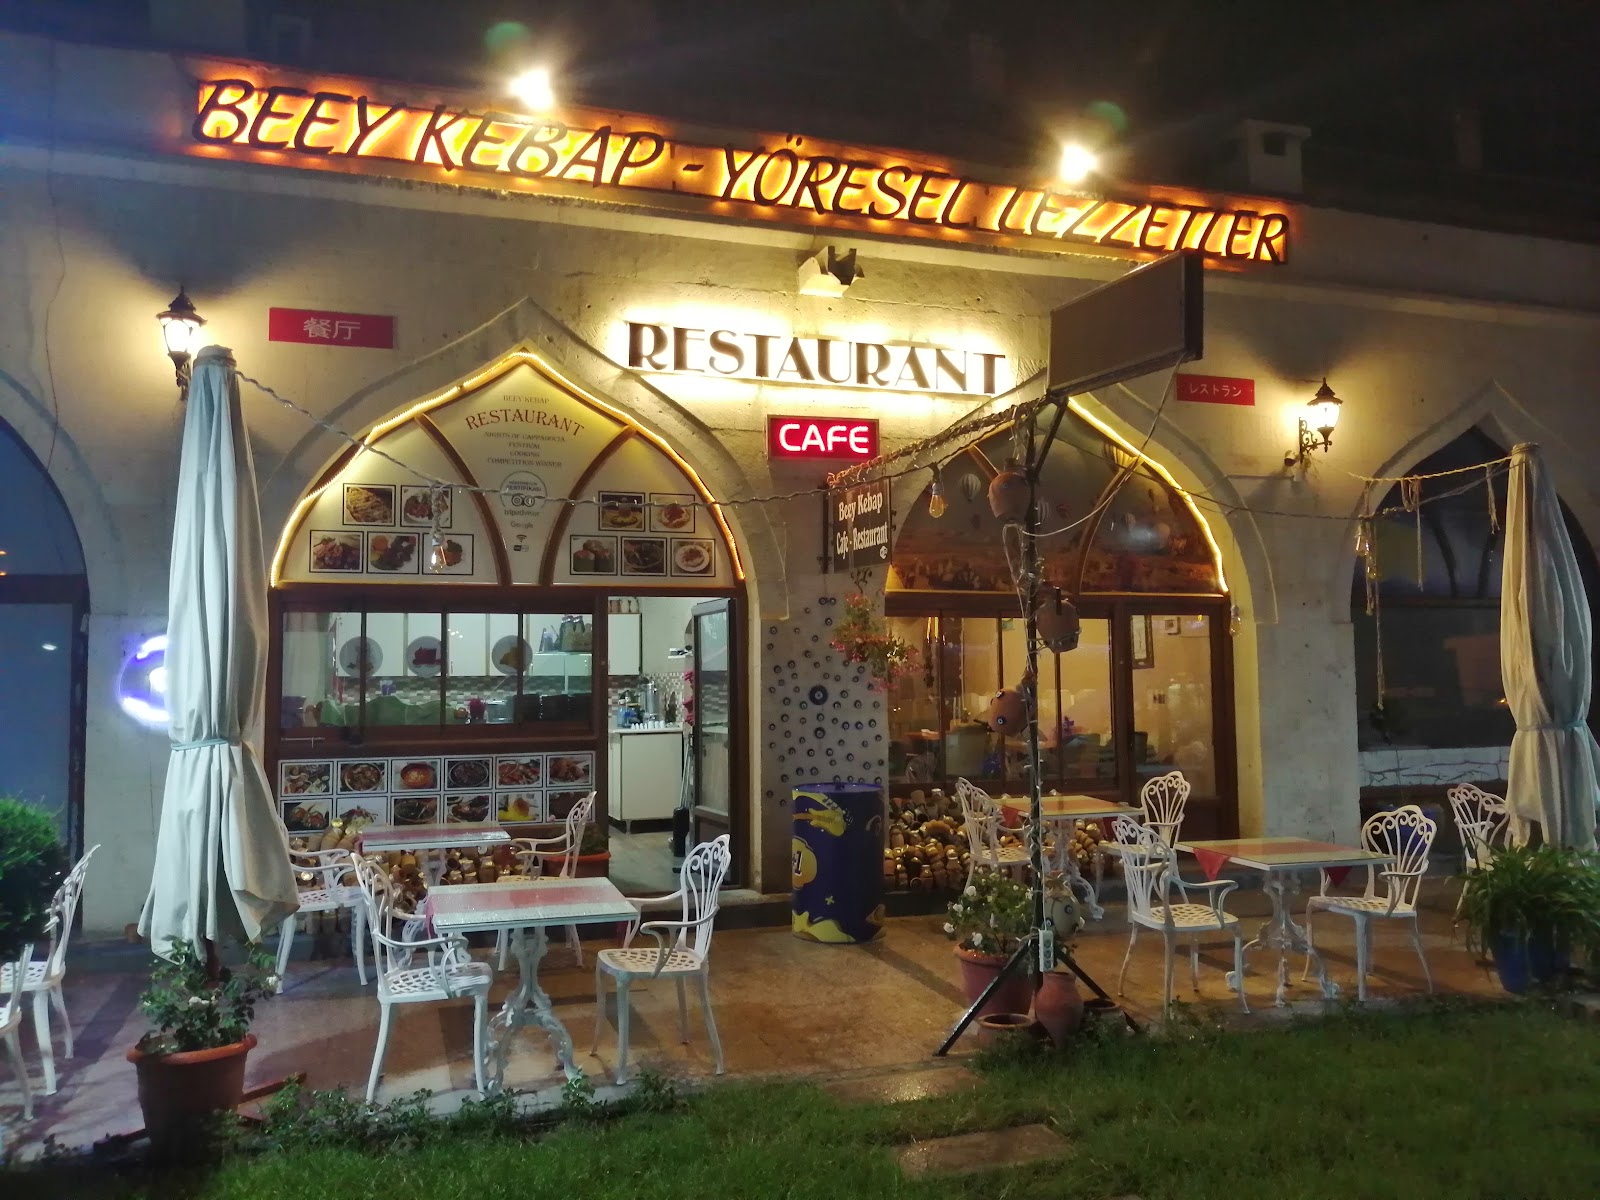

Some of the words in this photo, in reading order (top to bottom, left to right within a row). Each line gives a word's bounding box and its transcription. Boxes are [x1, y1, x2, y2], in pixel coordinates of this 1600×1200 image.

[192, 78, 406, 155] BEEY
[415, 104, 665, 187] KEBAP
[718, 134, 975, 231] YÖRESEL
[998, 186, 1291, 265] LEZZETLER
[303, 317, 361, 340] 餐厅
[626, 321, 1007, 394] RESTAURANT
[1190, 384, 1242, 397] レストラン
[465, 409, 585, 436] RESTAURANT
[508, 442, 541, 450] FESTIVAL
[779, 423, 869, 454] CAFE
[487, 457, 534, 466] COMPETITION
[535, 460, 562, 468] WINNER
[509, 450, 540, 458] COOKING
[839, 502, 856, 522] Beey
[857, 492, 883, 514] Kebap
[836, 530, 849, 559] Cafe
[853, 521, 888, 551] Restaurant
